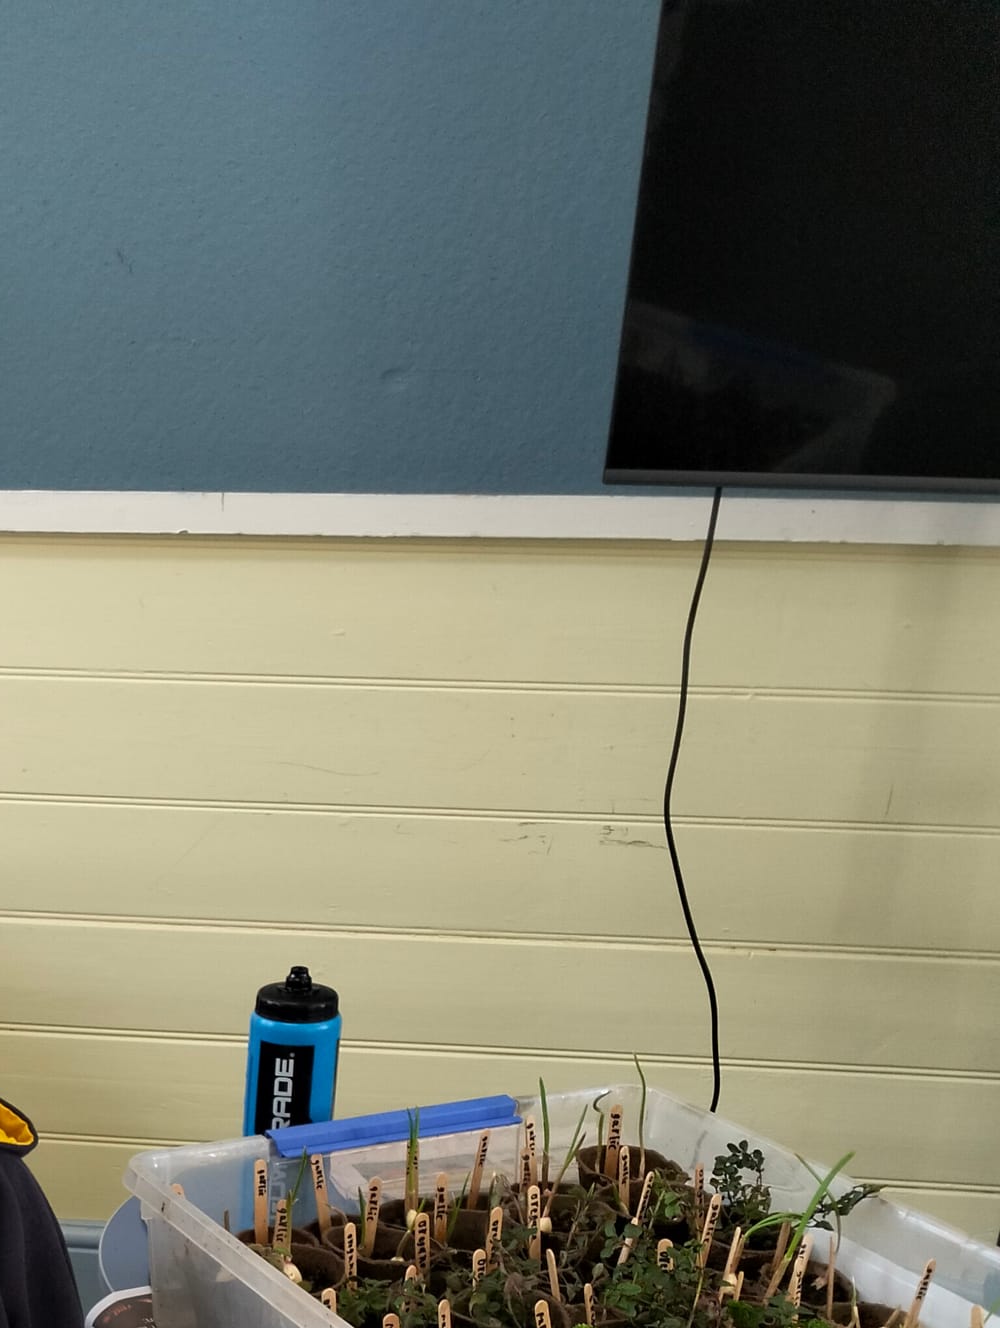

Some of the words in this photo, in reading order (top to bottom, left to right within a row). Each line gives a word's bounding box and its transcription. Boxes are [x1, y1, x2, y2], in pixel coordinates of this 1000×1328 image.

[609, 1114, 620, 1149] garlic
[478, 1136, 487, 1167] garlic
[257, 1170, 267, 1196] garlic
[311, 1160, 325, 1189] garlic
[367, 1186, 379, 1221] garlic
[276, 1208, 288, 1242] garlic
[704, 1204, 719, 1243] garlic
[418, 1221, 426, 1268] oregano
